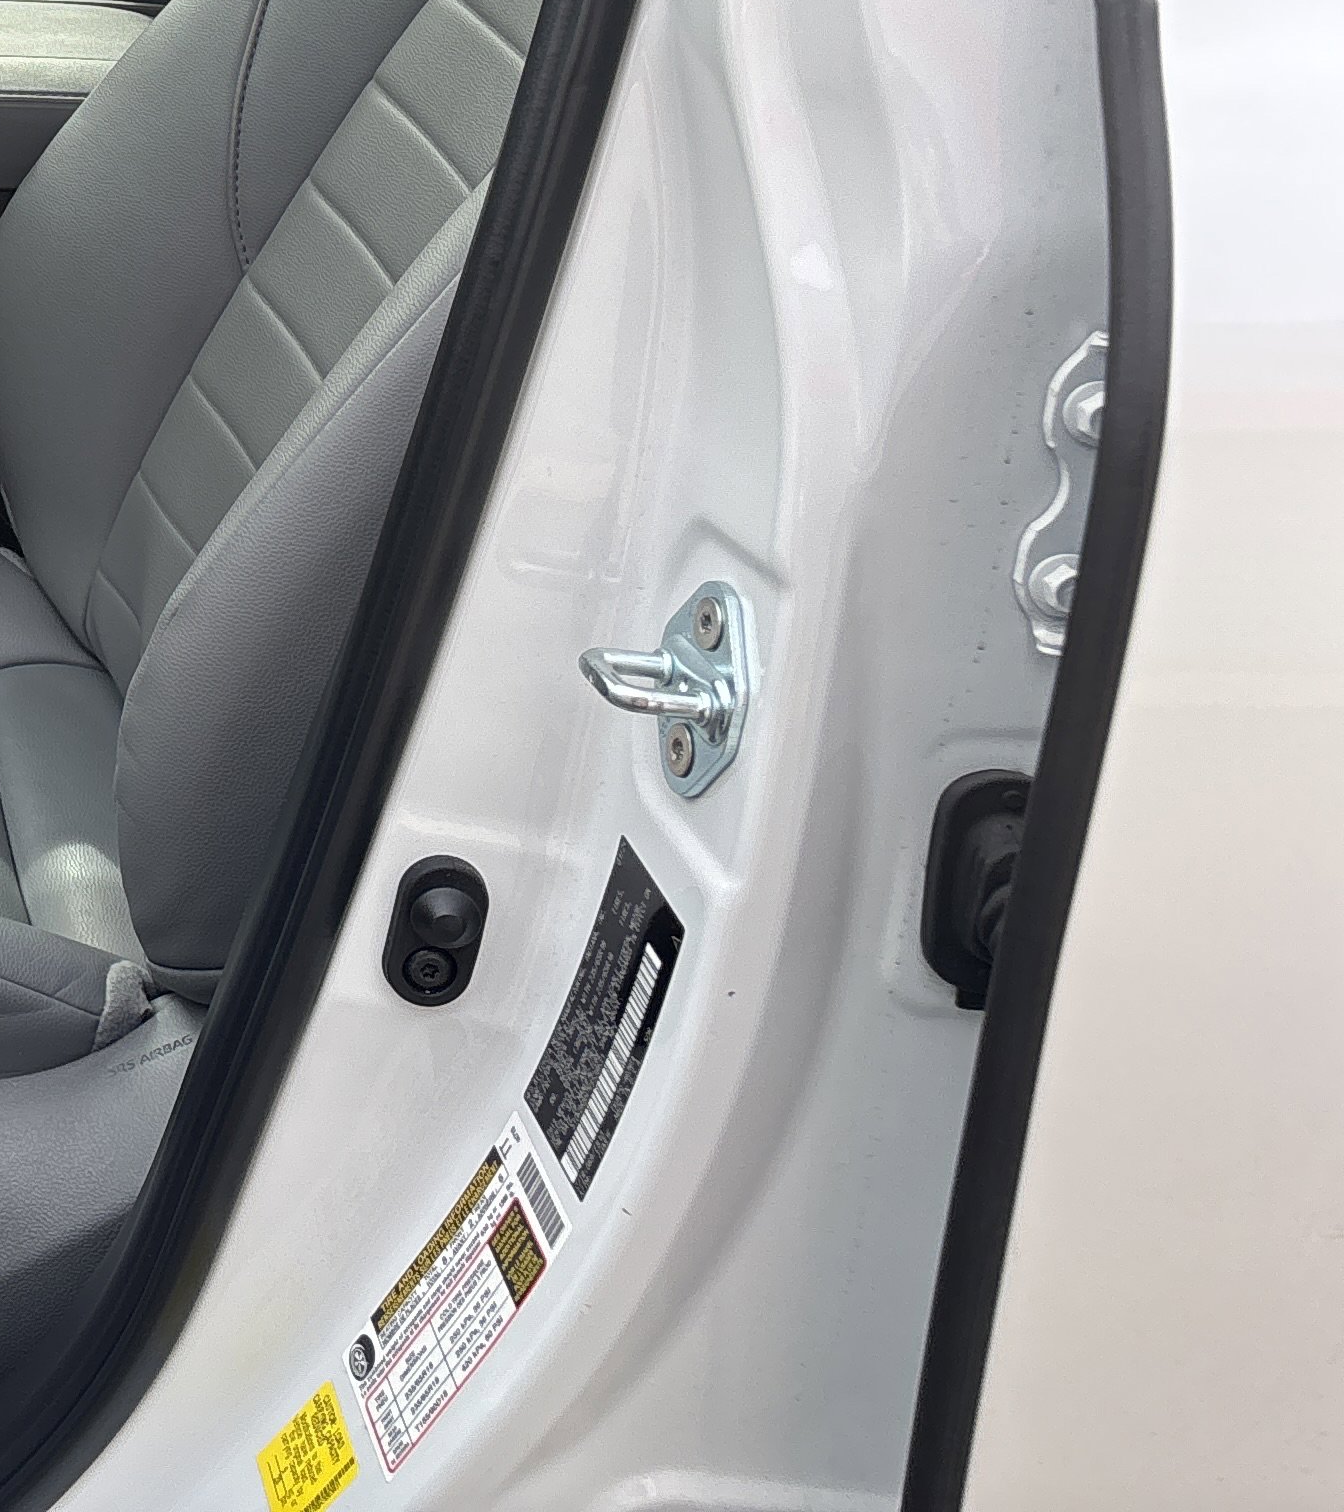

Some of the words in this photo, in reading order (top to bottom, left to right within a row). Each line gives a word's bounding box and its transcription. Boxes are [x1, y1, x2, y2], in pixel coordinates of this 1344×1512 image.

[382, 1288, 398, 1311] TIRE
[398, 1268, 413, 1290] AND
[413, 1226, 444, 1270] LOADING
[443, 1163, 488, 1227] INFORMATION
